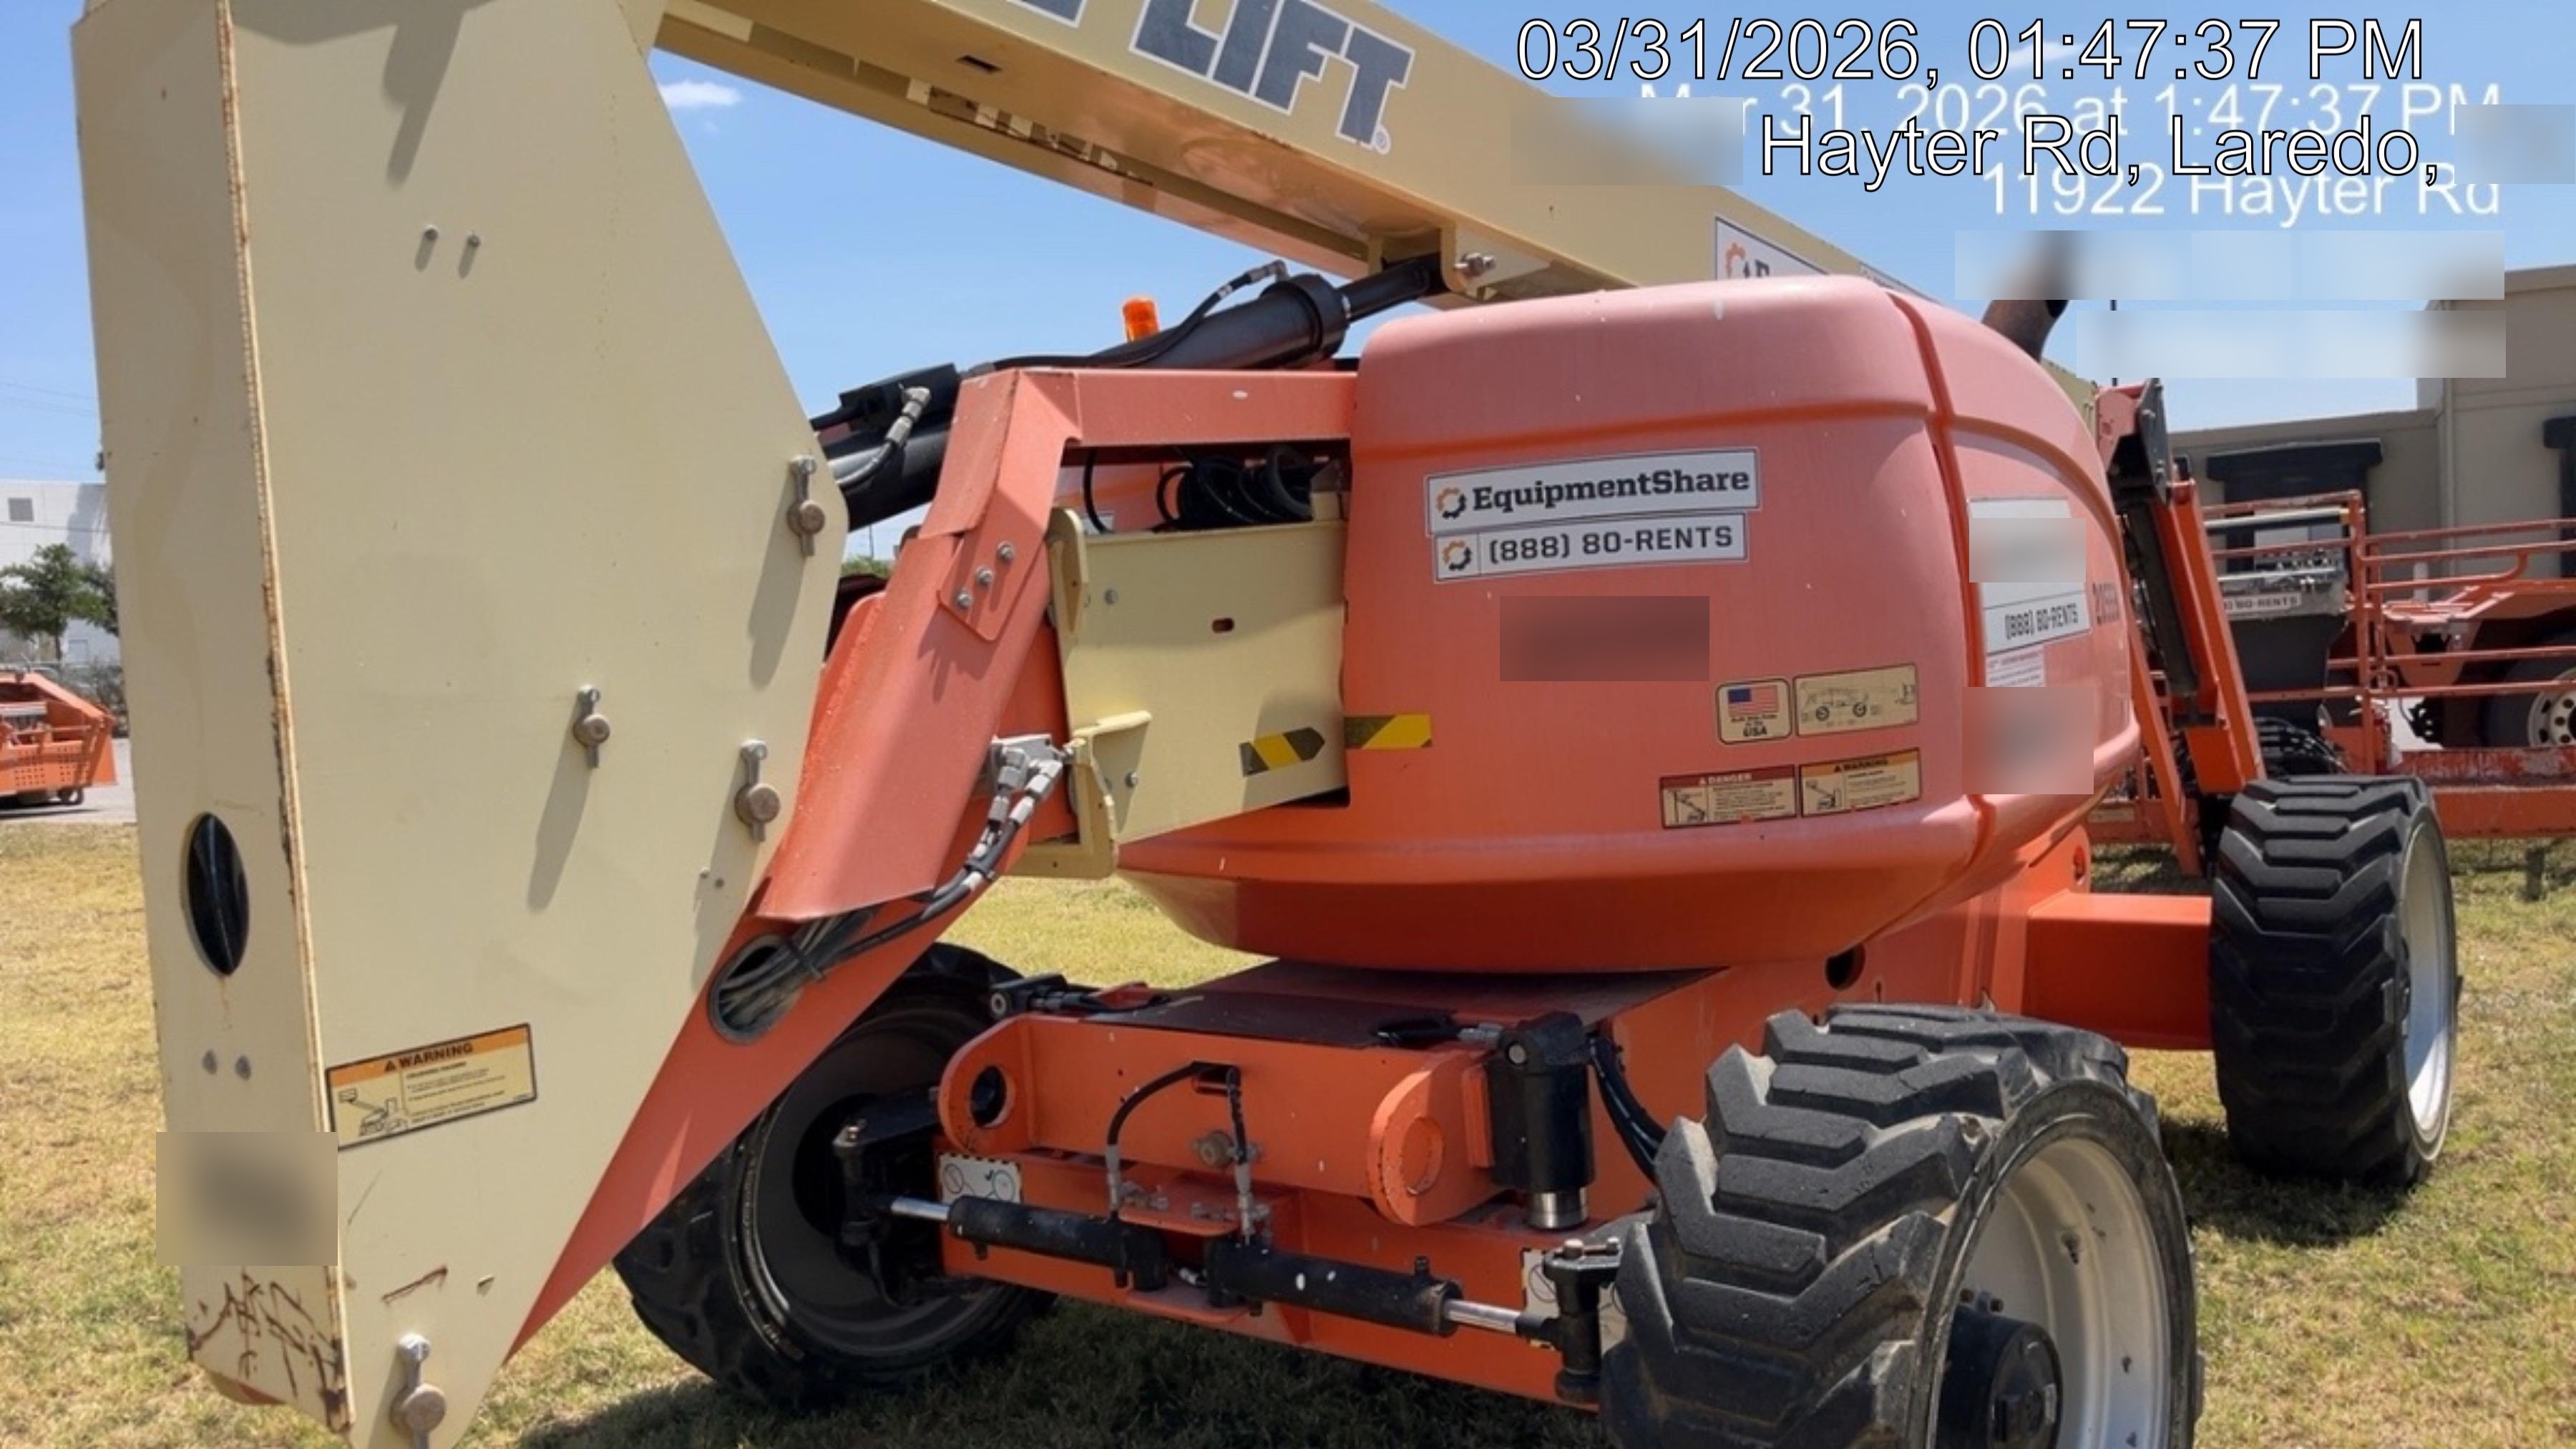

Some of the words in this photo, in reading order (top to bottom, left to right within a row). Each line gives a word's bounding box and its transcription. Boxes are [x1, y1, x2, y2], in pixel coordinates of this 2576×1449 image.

[1472, 470, 1750, 512] EquipmentShare
[1490, 533, 1570, 564] (888)
[1582, 526, 1732, 555] 80-RENTS
[399, 1043, 473, 1067] WARNING
